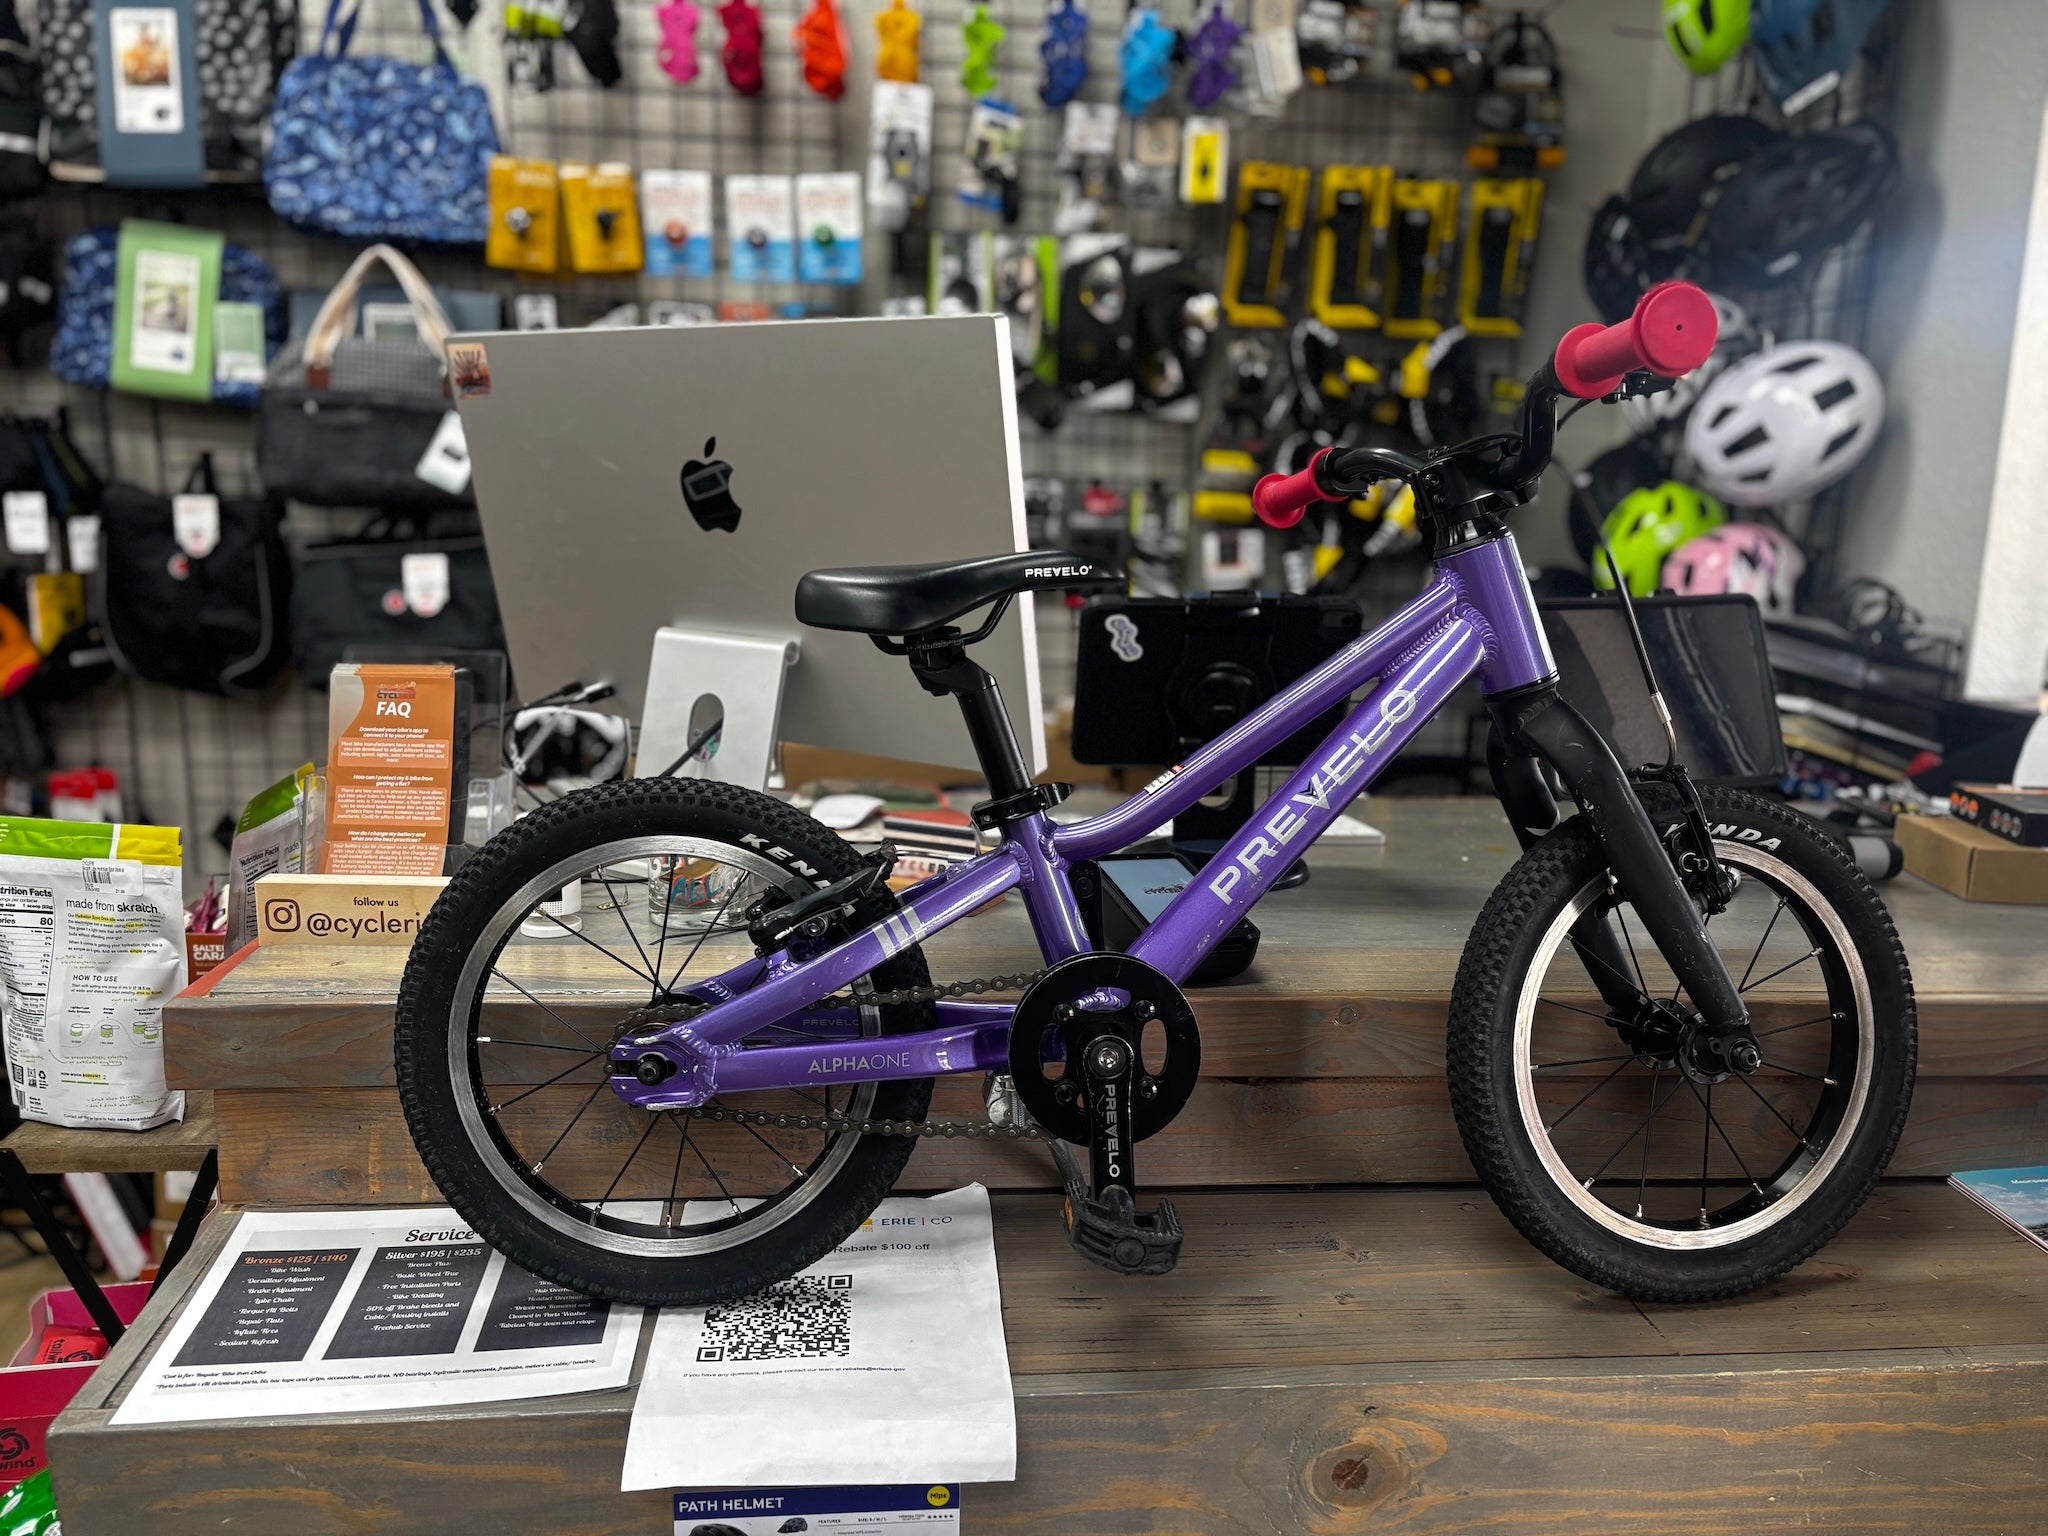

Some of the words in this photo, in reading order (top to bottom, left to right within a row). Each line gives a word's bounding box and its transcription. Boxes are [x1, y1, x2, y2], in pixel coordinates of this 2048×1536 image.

[1025, 565, 1089, 578] PREVELO
[376, 702, 411, 718] FAQ
[1208, 689, 1416, 905] PREVELO
[1663, 822, 1782, 851] KNDA
[240, 850, 263, 866] Nutrition
[264, 846, 280, 857] Facts
[29, 888, 53, 898] Facts
[66, 899, 93, 909] made
[95, 901, 115, 912] from
[353, 896, 385, 907] follow
[387, 899, 399, 907] us
[40, 917, 53, 926] 80
[307, 910, 422, 939] @cycleri
[72, 974, 91, 982] HOW
[807, 1052, 911, 1074] ALPHAONE
[1104, 1084, 1121, 1178] PREVELO
[881, 1217, 916, 1226] ERIE
[930, 1216, 953, 1225] CO
[405, 1228, 475, 1243] Service
[833, 1244, 878, 1253] Rebate
[881, 1243, 912, 1251] $100
[244, 1256, 285, 1265] Bronze
[286, 1255, 312, 1264] $125
[320, 1254, 349, 1262] $140
[385, 1251, 419, 1260] Silver
[420, 1250, 445, 1258] $195
[453, 1248, 481, 1256] $235
[284, 1276, 326, 1284] Adjustment
[272, 1286, 314, 1294] Adjustment
[403, 1322, 431, 1330] Service
[233, 1329, 259, 1337] Inflate
[250, 1338, 280, 1346] Refresh
[930, 1492, 947, 1500] Mips
[678, 1500, 718, 1513] PATH
[722, 1497, 785, 1511] HELMET
